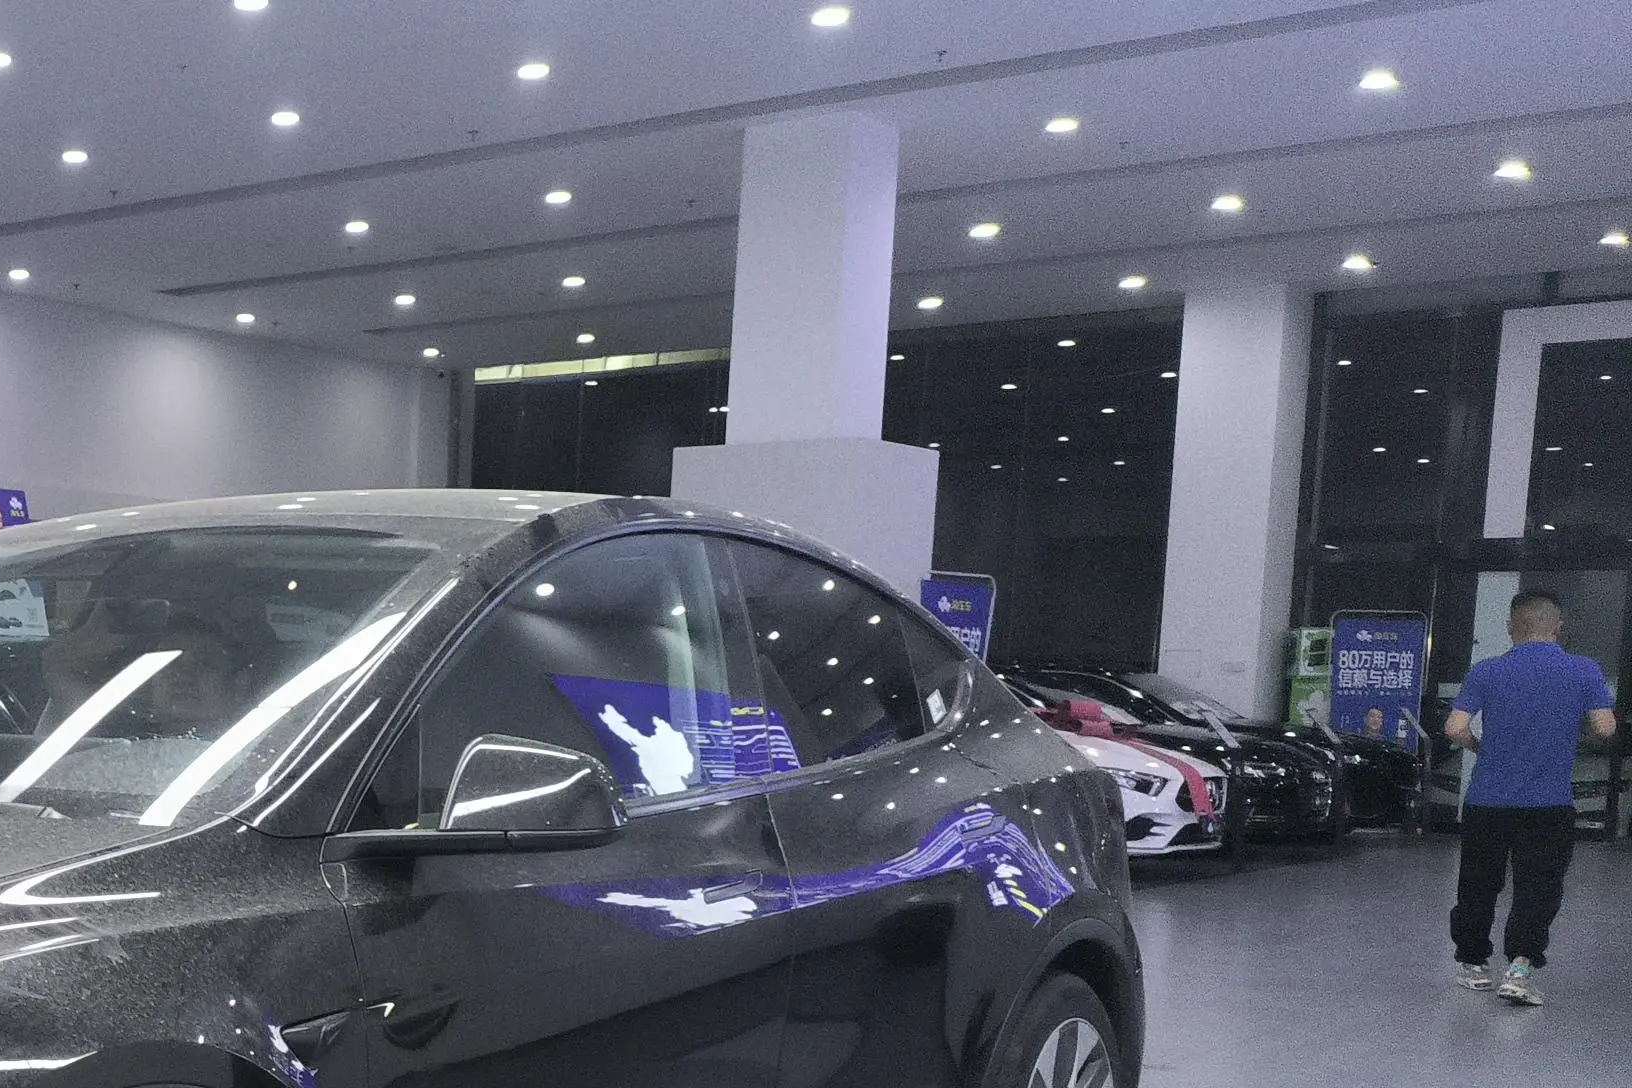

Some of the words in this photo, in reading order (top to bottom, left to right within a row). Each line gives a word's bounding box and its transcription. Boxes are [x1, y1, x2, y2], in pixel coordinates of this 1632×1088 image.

[1339, 650, 1415, 669] 80万用户的
[1338, 669, 1413, 689] 信赖与选择
